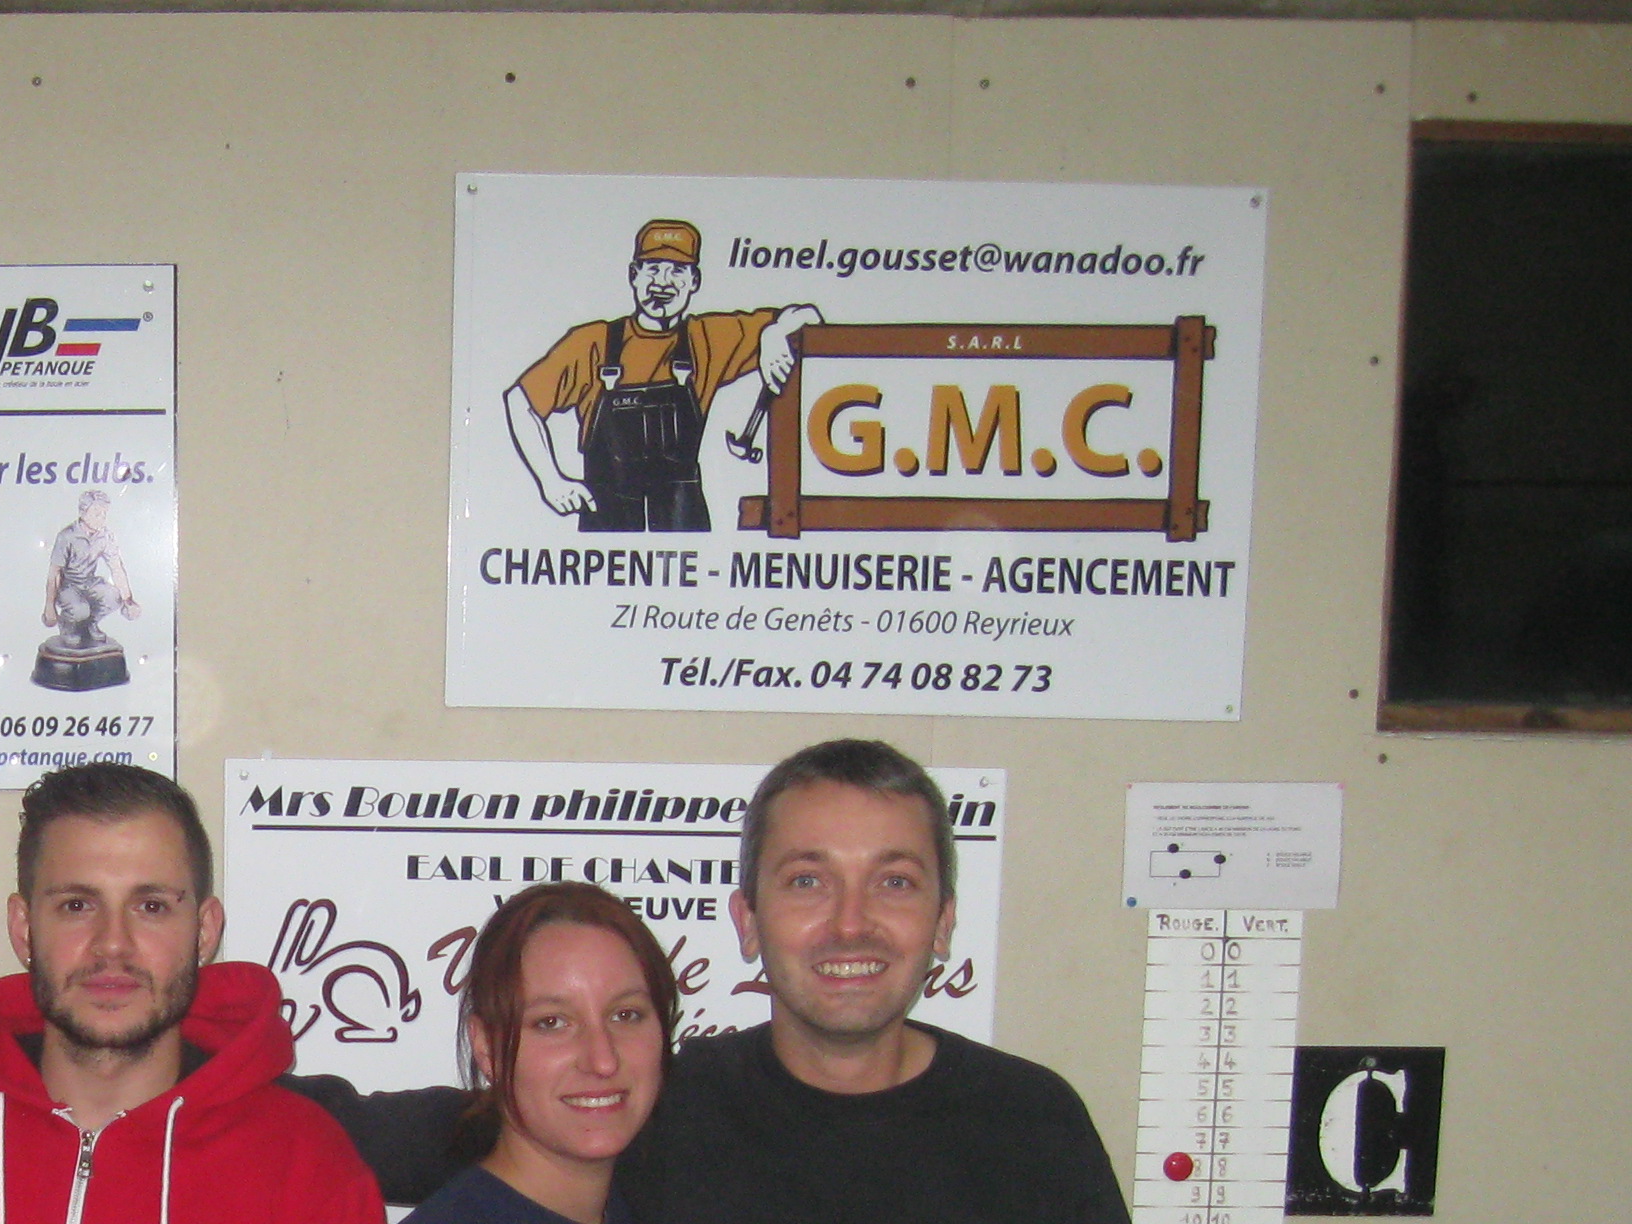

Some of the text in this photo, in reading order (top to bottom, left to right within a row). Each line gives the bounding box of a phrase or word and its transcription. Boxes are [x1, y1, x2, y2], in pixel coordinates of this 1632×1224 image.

[728, 237, 1205, 278] lionel.gousset@wanadoo.fr
[0, 361, 96, 376] PETANQUE
[806, 383, 1163, 478] G.M.C.
[15, 452, 58, 485] les
[66, 452, 155, 485] clubs.
[479, 547, 699, 588] CHARPENTE
[729, 551, 952, 592] MENUISERIE
[981, 556, 1236, 598] AGENCEMENT
[642, 605, 720, 631] Route
[725, 605, 757, 631] de
[763, 607, 854, 633] Genêts
[876, 610, 958, 635] 01600
[963, 611, 1076, 641] Reyrieux
[660, 656, 1053, 693] Tél./Fax. 04 74 08 82 73
[0, 716, 27, 737] 06
[31, 716, 59, 737] 09
[62, 716, 90, 737] 26
[94, 716, 122, 737] 46
[126, 715, 155, 737] 77
[239, 784, 334, 818] Mrs
[343, 786, 521, 820] Boulon
[530, 788, 748, 823] philippe
[406, 854, 513, 882] EARL
[583, 857, 742, 886] CHANTE
[1200, 941, 1241, 961] 0 0
[1200, 968, 1241, 989] 1 1
[1200, 997, 1238, 1016] 2 2
[1199, 1024, 1237, 1043] 3 3
[1197, 1051, 1237, 1070] 4 4
[1197, 1078, 1235, 1097] 5 5
[1196, 1105, 1233, 1123] 6 6
[1195, 1131, 1231, 1149] 7 7
[1318, 1069, 1408, 1194] C
[1218, 1157, 1228, 1177] 8
